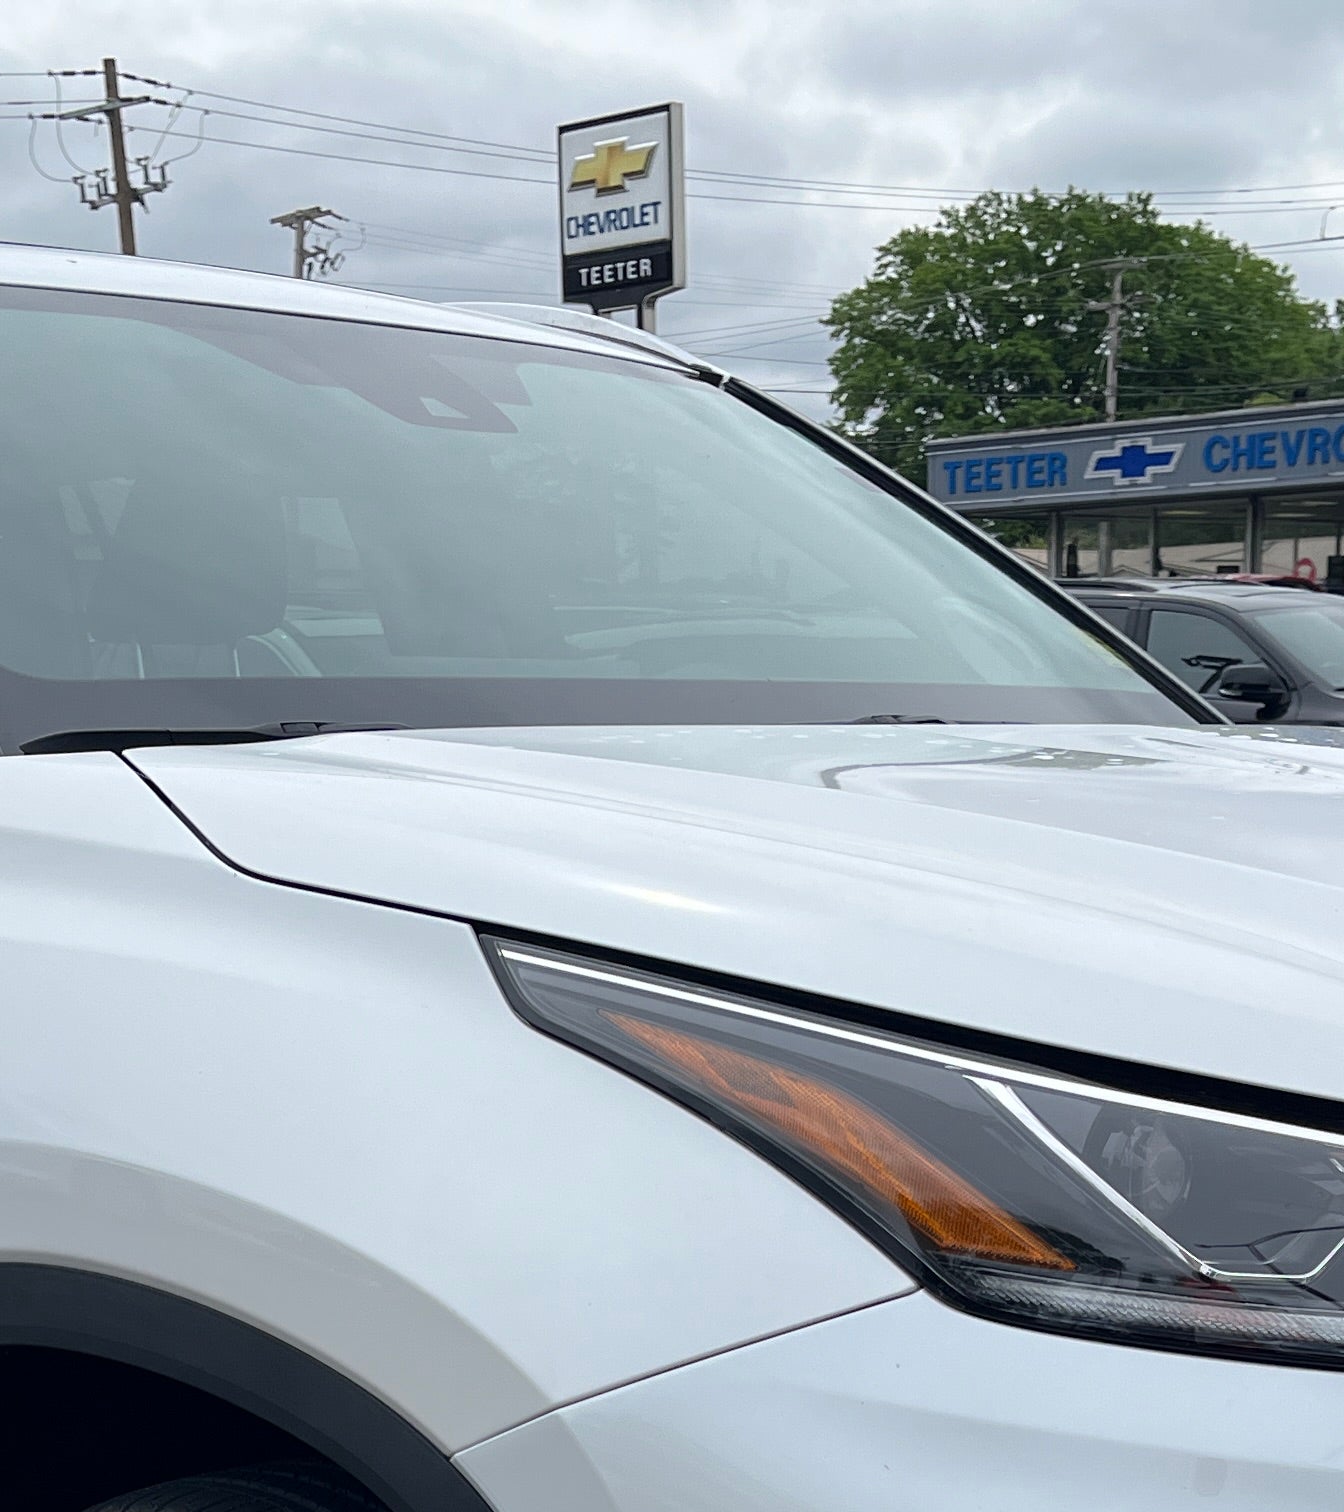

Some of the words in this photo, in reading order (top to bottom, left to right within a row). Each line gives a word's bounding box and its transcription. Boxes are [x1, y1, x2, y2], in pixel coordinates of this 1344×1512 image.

[566, 201, 662, 239] CHEVROLET
[578, 258, 653, 287] TEETER
[943, 451, 1068, 495] TEETER
